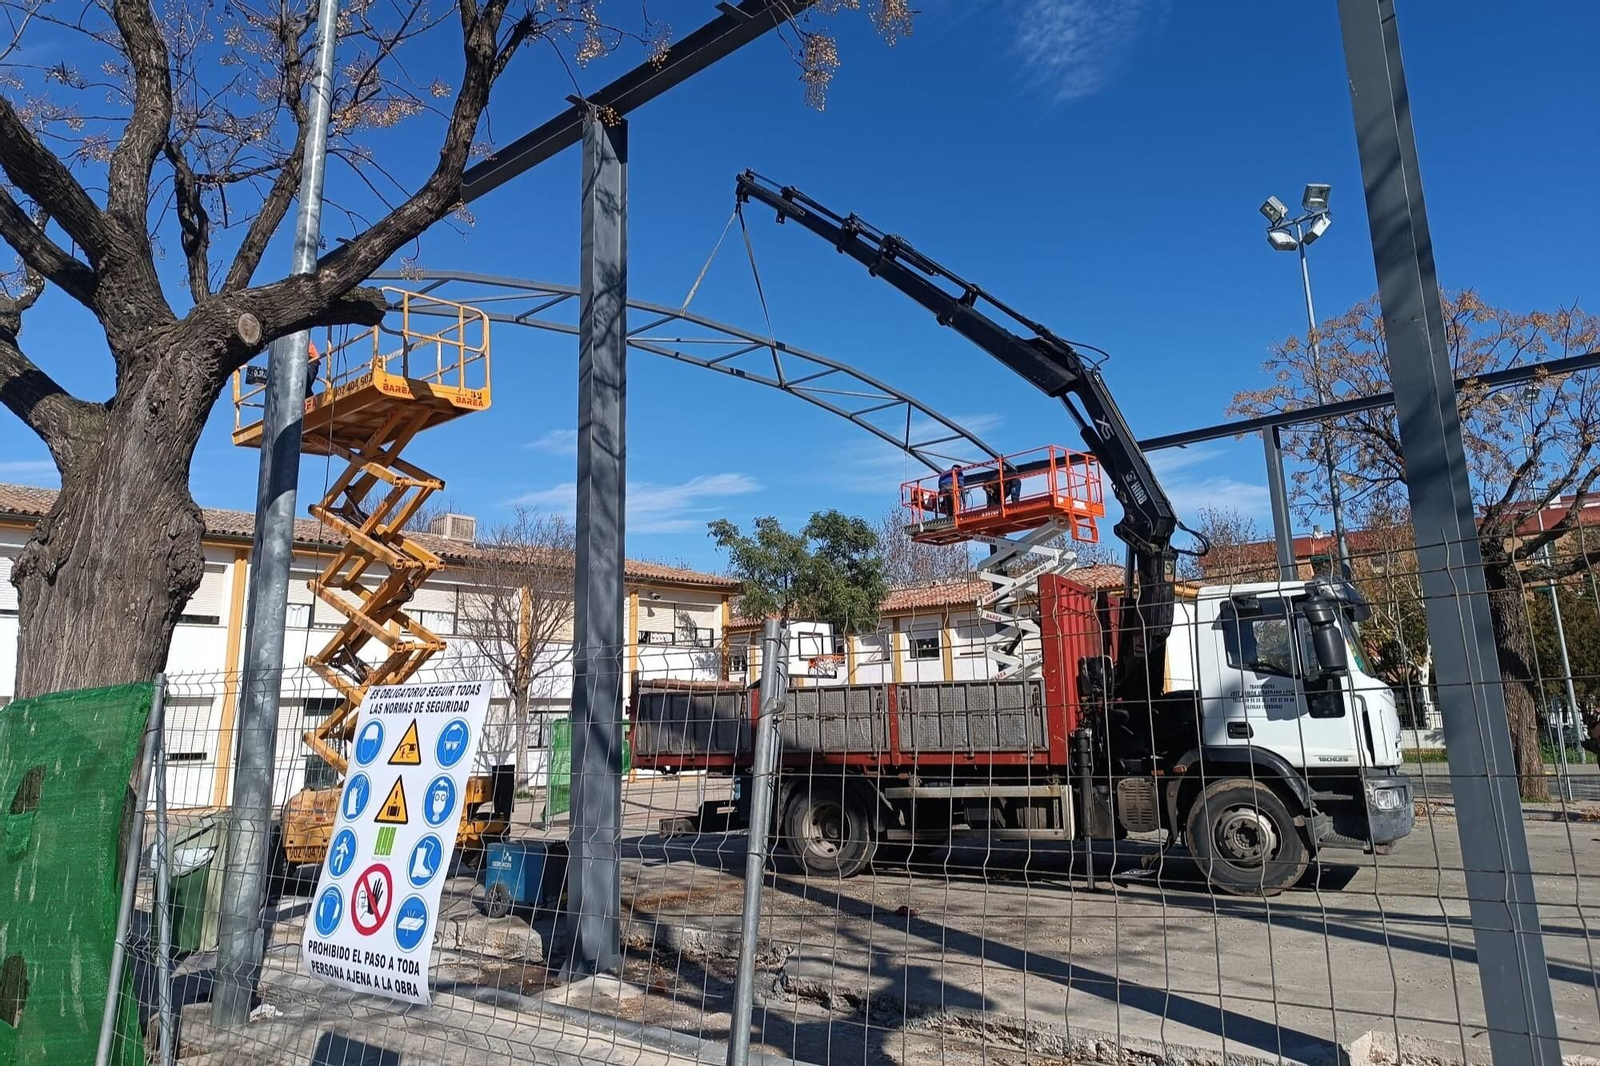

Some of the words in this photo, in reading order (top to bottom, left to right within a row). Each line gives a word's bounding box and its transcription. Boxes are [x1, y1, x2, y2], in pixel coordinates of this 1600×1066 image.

[456, 396, 484, 408] BAREA
[1096, 414, 1115, 440] XS
[1130, 480, 1148, 506] HIAB
[370, 689, 380, 699] ES
[380, 686, 427, 699] OBLIGATORIO
[426, 685, 454, 697] SEGUIR
[456, 684, 481, 696] TODAS
[369, 703, 382, 714] LAS
[384, 701, 412, 714] NORMAS
[414, 701, 423, 713] DE
[426, 700, 470, 713] SEGURIDAD
[308, 940, 350, 961] PROHIBIDO
[352, 949, 362, 963] EL
[364, 951, 386, 969] PASO
[388, 956, 394, 971] A
[397, 958, 420, 976] TODA
[311, 960, 344, 980] PERSONA
[346, 970, 372, 987] AJENA
[374, 975, 380, 989] A
[382, 976, 393, 992] LA
[395, 980, 419, 997] OBRA
